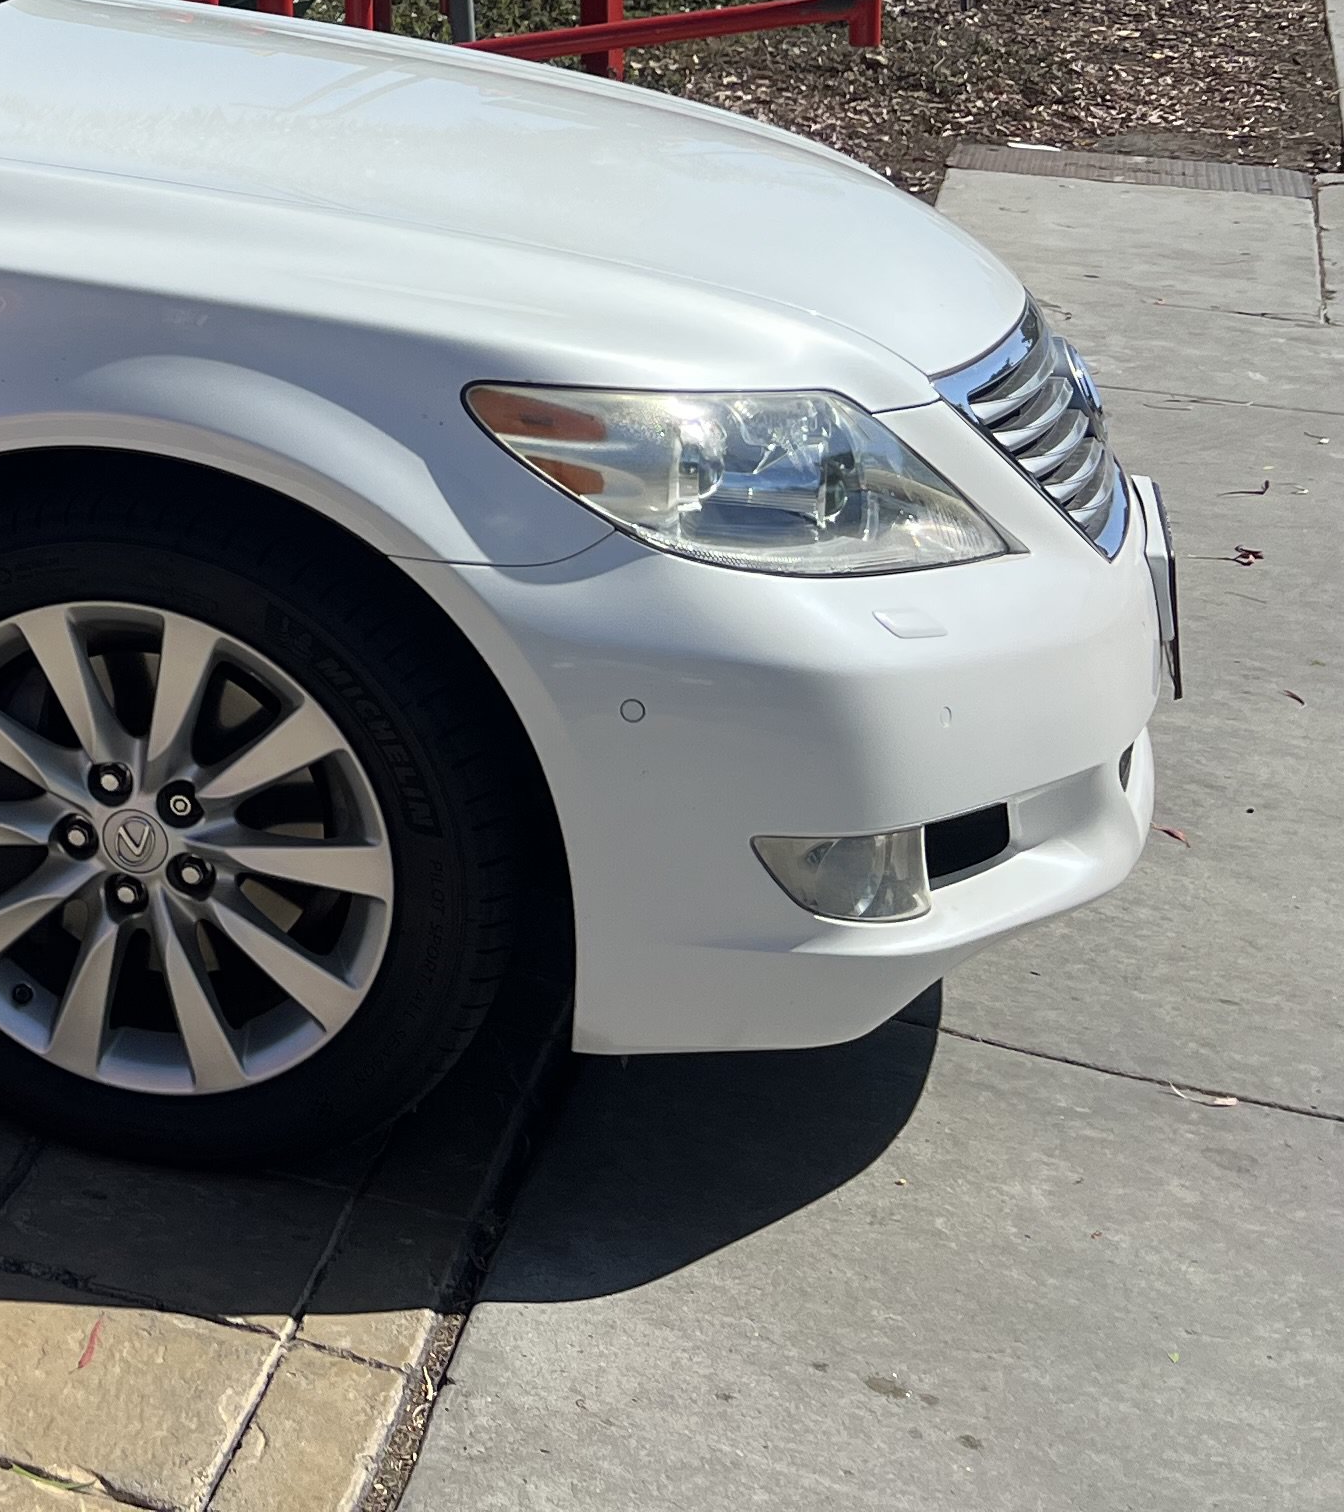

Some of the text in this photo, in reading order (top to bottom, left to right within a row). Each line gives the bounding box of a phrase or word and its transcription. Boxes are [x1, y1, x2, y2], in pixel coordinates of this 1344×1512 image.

[315, 658, 434, 826] MICHELIN
[430, 859, 445, 916] PILOT
[420, 921, 444, 986] SPORT
